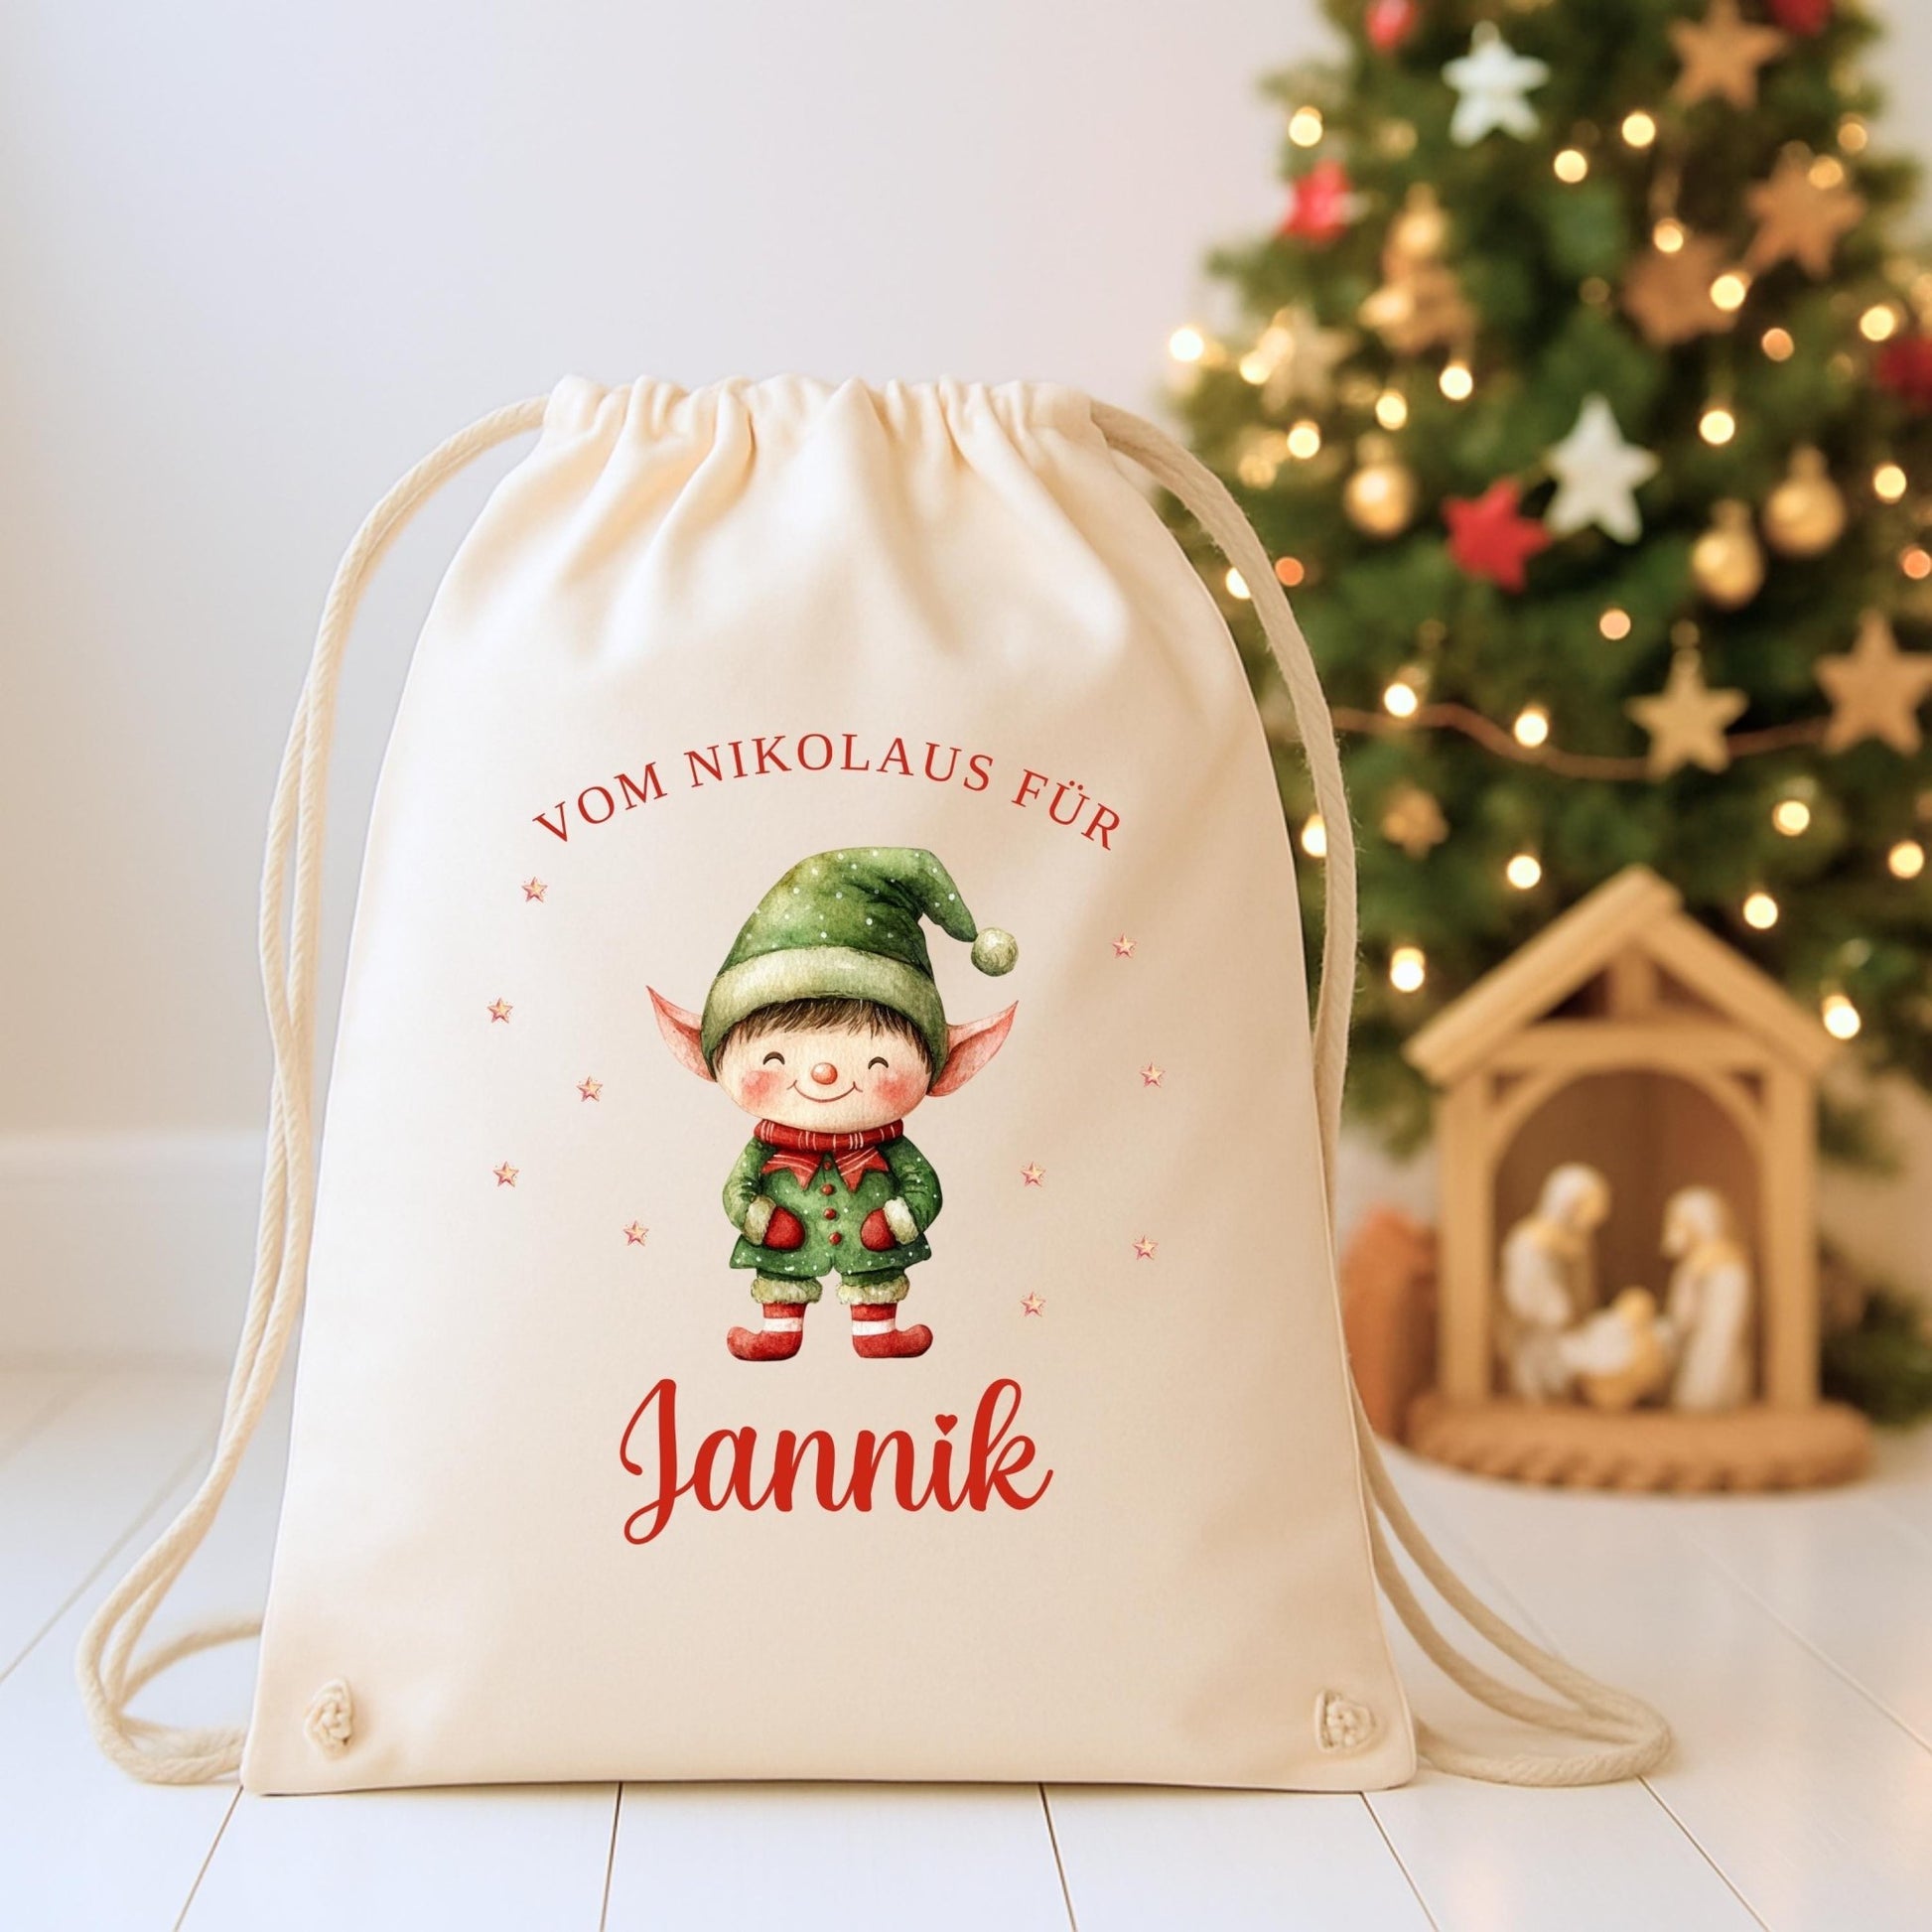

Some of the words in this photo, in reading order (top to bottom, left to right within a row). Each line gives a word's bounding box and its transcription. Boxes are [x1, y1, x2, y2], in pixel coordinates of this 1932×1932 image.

[532, 761, 667, 844] VOM
[684, 733, 995, 793] NIKOLAUS
[1011, 768, 1122, 851] FÜR
[619, 1376, 1055, 1546] Jannik
